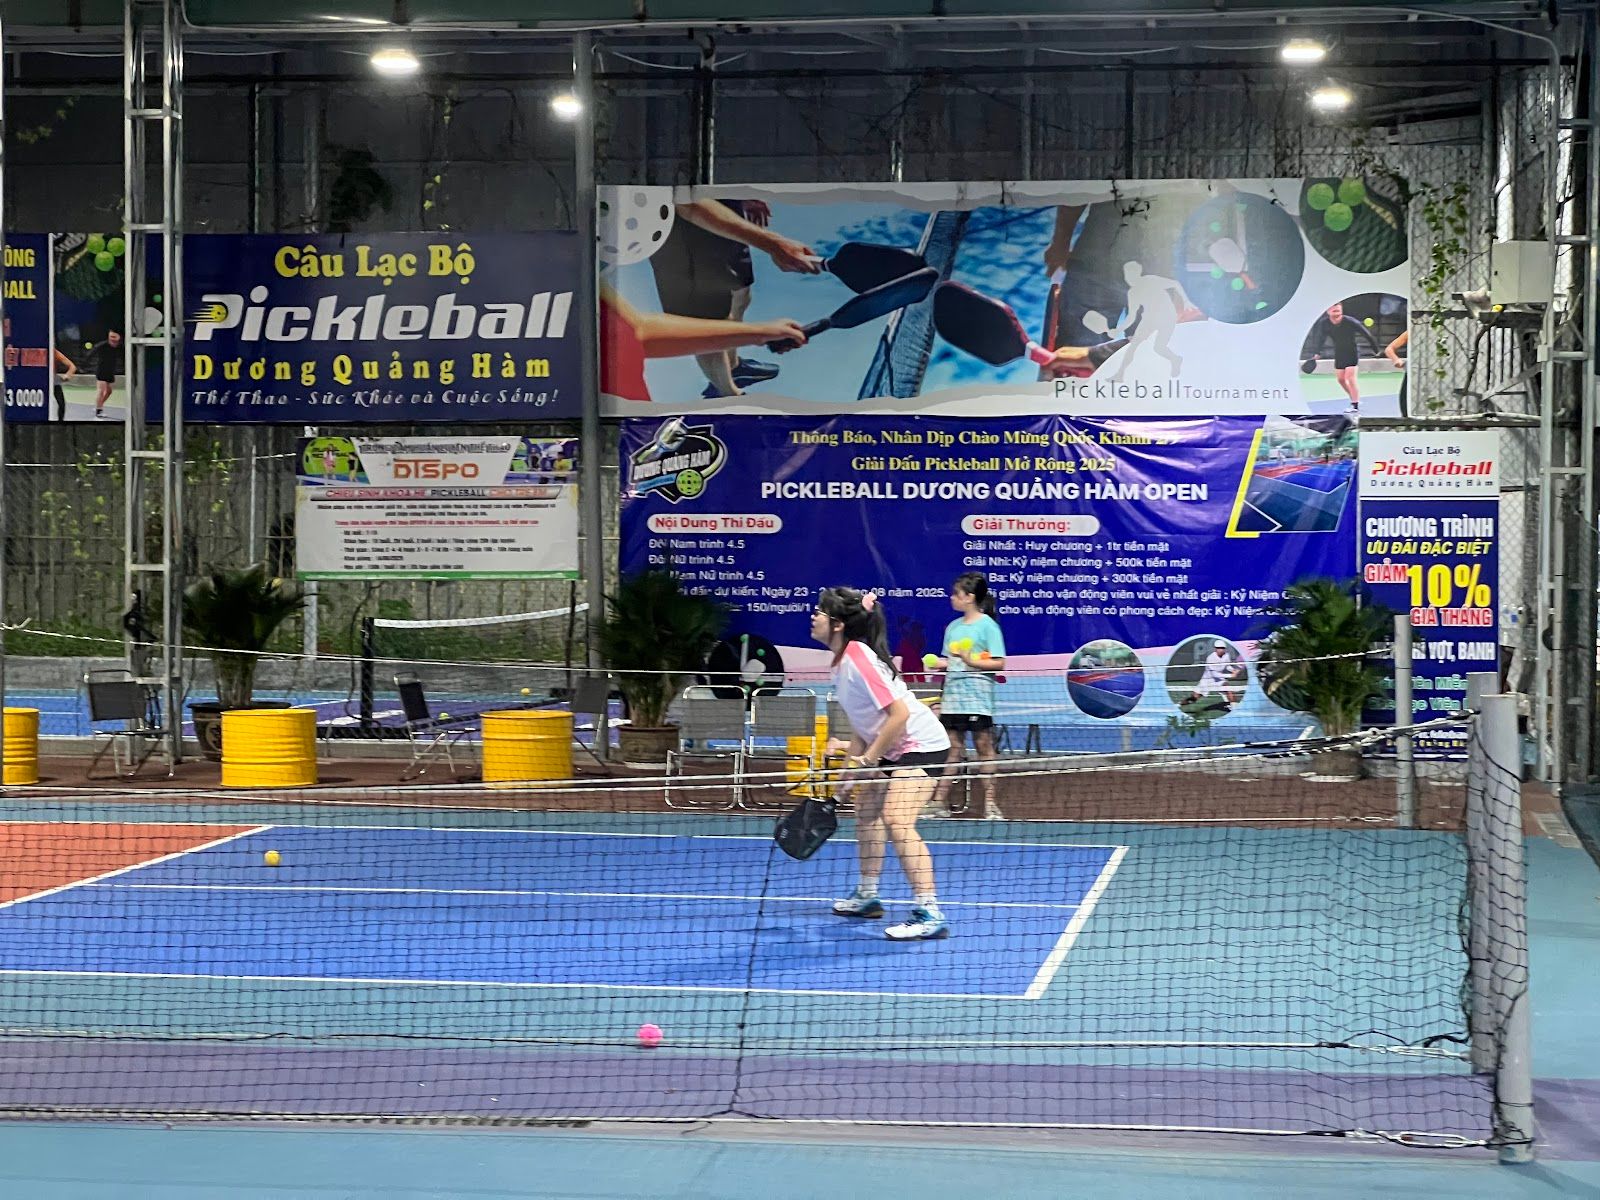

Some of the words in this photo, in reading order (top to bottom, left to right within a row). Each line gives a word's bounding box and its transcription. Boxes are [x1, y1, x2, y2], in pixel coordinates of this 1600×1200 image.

[275, 245, 345, 278] Câu
[355, 245, 417, 286] Lạc
[428, 242, 475, 285] Bộ
[193, 285, 573, 341] Pickleball
[193, 353, 317, 386] Dương
[332, 350, 456, 386] Quảng
[471, 351, 551, 379] Hàm
[16, 389, 45, 408] 0000
[236, 389, 289, 405] Thao
[308, 391, 345, 405] Sức
[411, 390, 434, 404] và
[441, 389, 492, 406] Cuộc
[497, 387, 559, 407] Sống!
[1054, 380, 1181, 399] Pickleball
[1183, 385, 1289, 399] Tournament
[789, 430, 839, 447] Thông
[842, 429, 878, 446] Báo,
[881, 430, 923, 444] Nhân
[926, 430, 955, 448] Dịp
[958, 430, 1000, 444] Chào
[1003, 431, 1050, 447] Mừng
[1053, 429, 1095, 447] Quốc
[1426, 446, 1444, 457] Lạc
[392, 458, 480, 480] DTSPO
[851, 456, 885, 471] Giải
[889, 454, 921, 471] Đấu
[924, 457, 1000, 471] Pickleball
[1004, 456, 1031, 471] Mở
[1034, 456, 1076, 474] Rộng
[1079, 458, 1115, 471] 2025
[1371, 459, 1493, 476] Pickleball
[431, 488, 486, 498] PICKLEBALL
[761, 482, 899, 499] PICKLEBALL
[902, 481, 990, 500] DƯƠNG
[994, 476, 1080, 501] QUẢNG
[1084, 478, 1139, 500] HÀM
[1143, 483, 1209, 501] OPEN
[1370, 479, 1413, 488] Dương
[1418, 479, 1460, 488] Quảng
[1466, 479, 1493, 487] Hàm
[655, 516, 677, 530] Nội
[680, 517, 718, 531] Dung
[721, 517, 743, 529] Thi
[745, 516, 775, 529] Đấu
[973, 518, 1003, 530] Giải
[1006, 517, 1071, 533] Thưởng:
[1365, 515, 1438, 538] CHƯƠNG
[1440, 513, 1494, 538] TRÌNH
[669, 539, 697, 549] Nam
[726, 539, 745, 549] 4.5
[963, 541, 987, 551] Giải
[988, 540, 1016, 551] Nhất
[1025, 541, 1047, 553] Huy
[1050, 541, 1092, 553] chương
[1107, 541, 1121, 551] 1tr
[1147, 541, 1170, 553] mặt
[1366, 539, 1390, 555] ƯU
[1390, 538, 1418, 555] ĐÃI
[1420, 538, 1454, 557] ĐẶC
[1455, 538, 1493, 557] BIỆT
[716, 555, 735, 565] 4.5
[963, 556, 987, 567] Giải
[1030, 556, 1058, 568] niệm
[1060, 557, 1103, 569] chương
[1115, 557, 1144, 567] 500k
[1169, 558, 1192, 569] mặt
[698, 570, 716, 580] Nữ
[746, 571, 765, 580] 4.5
[988, 573, 1008, 583] Ba:
[1027, 573, 1055, 585] niệm
[1056, 573, 1099, 585] chương
[1111, 573, 1140, 583] 300k
[1166, 574, 1189, 585] mặt
[1364, 557, 1409, 584] GIẢM
[761, 586, 791, 599] Ngày
[793, 587, 809, 596] 23
[888, 588, 914, 597] năm
[1032, 589, 1054, 599] cho
[1055, 589, 1078, 601] vận
[1079, 588, 1109, 601] động
[1110, 588, 1135, 599] viên
[1136, 590, 1155, 600] vui
[1156, 588, 1171, 600] vẻ
[1172, 588, 1199, 600] nhất
[1200, 589, 1222, 601] giải
[1249, 589, 1280, 602] Niệm
[1406, 563, 1492, 608] 10%
[998, 605, 1021, 615] cho
[1022, 605, 1044, 617] vận
[1045, 605, 1075, 617] động
[1076, 605, 1101, 615] viên
[1102, 605, 1118, 615] có
[1119, 606, 1156, 618] phong
[1157, 606, 1185, 616] cách
[1187, 606, 1213, 617] đẹp:
[1410, 603, 1439, 627] GIÁ
[1440, 603, 1494, 627] THÁNG
[1457, 641, 1496, 661] BANH
